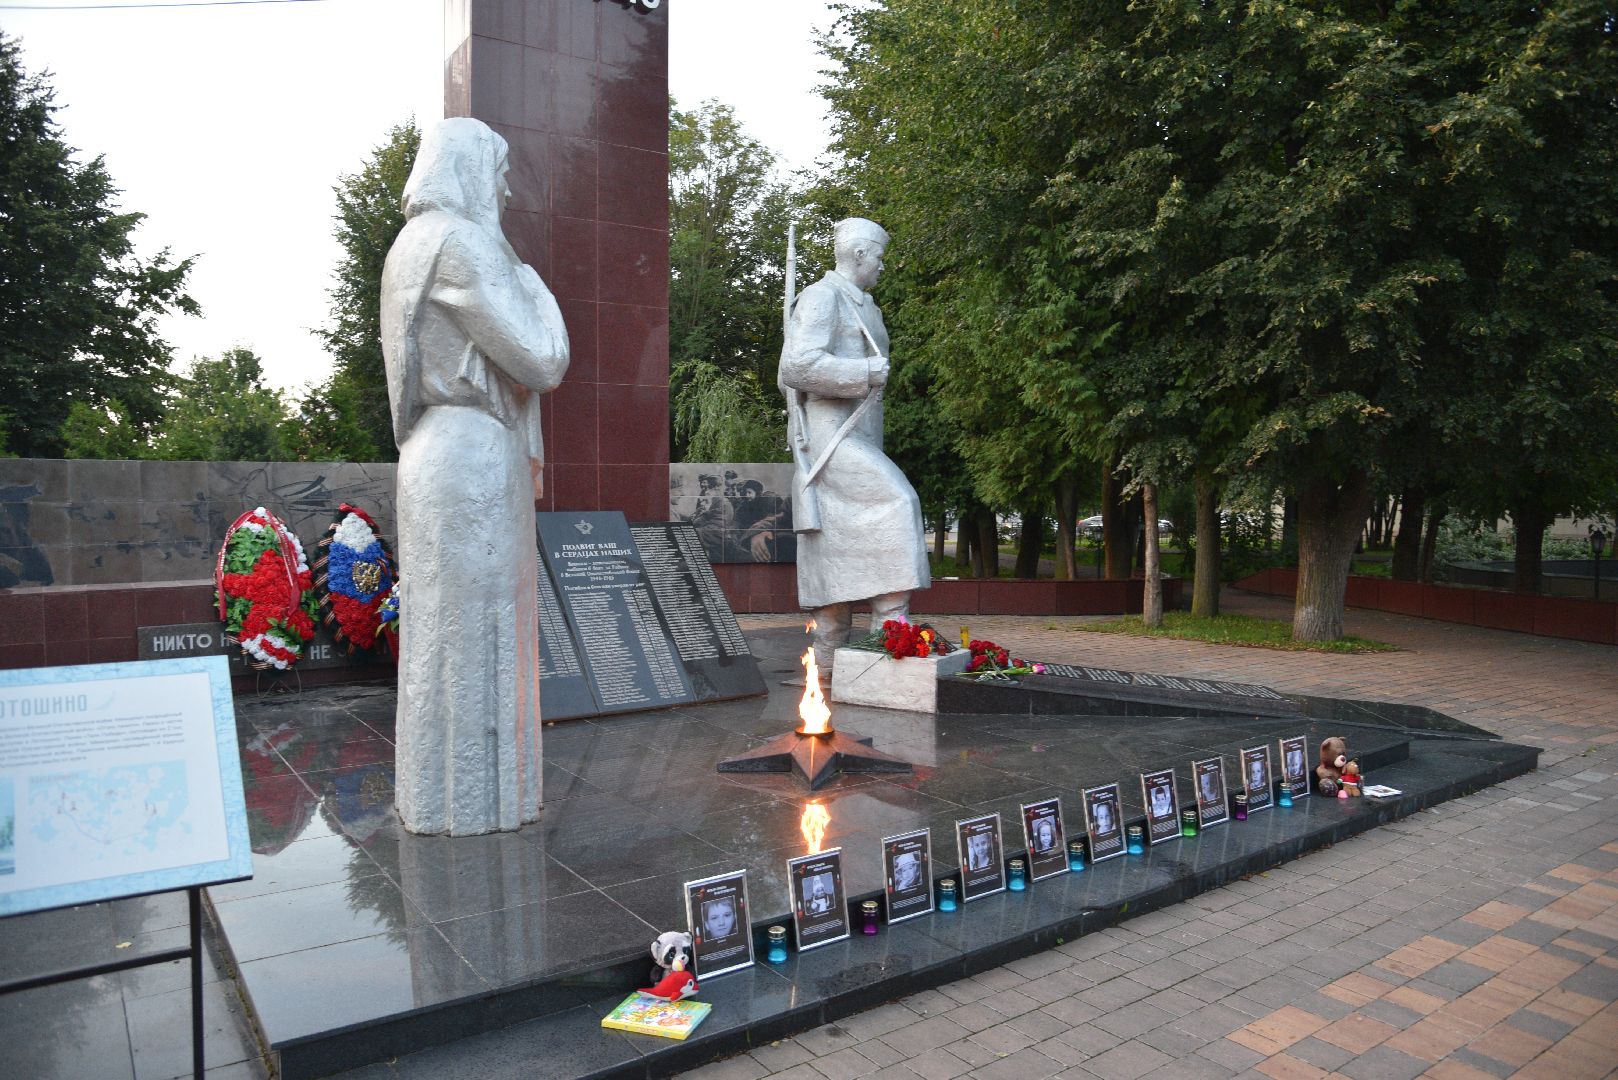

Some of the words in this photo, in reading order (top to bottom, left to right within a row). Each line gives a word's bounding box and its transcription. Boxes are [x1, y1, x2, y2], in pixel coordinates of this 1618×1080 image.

[562, 543, 595, 551] ПОДВИГ
[561, 550, 599, 559] СЕРДЦАХ
[153, 633, 213, 652] НИКТО
[310, 644, 332, 660] НЕ
